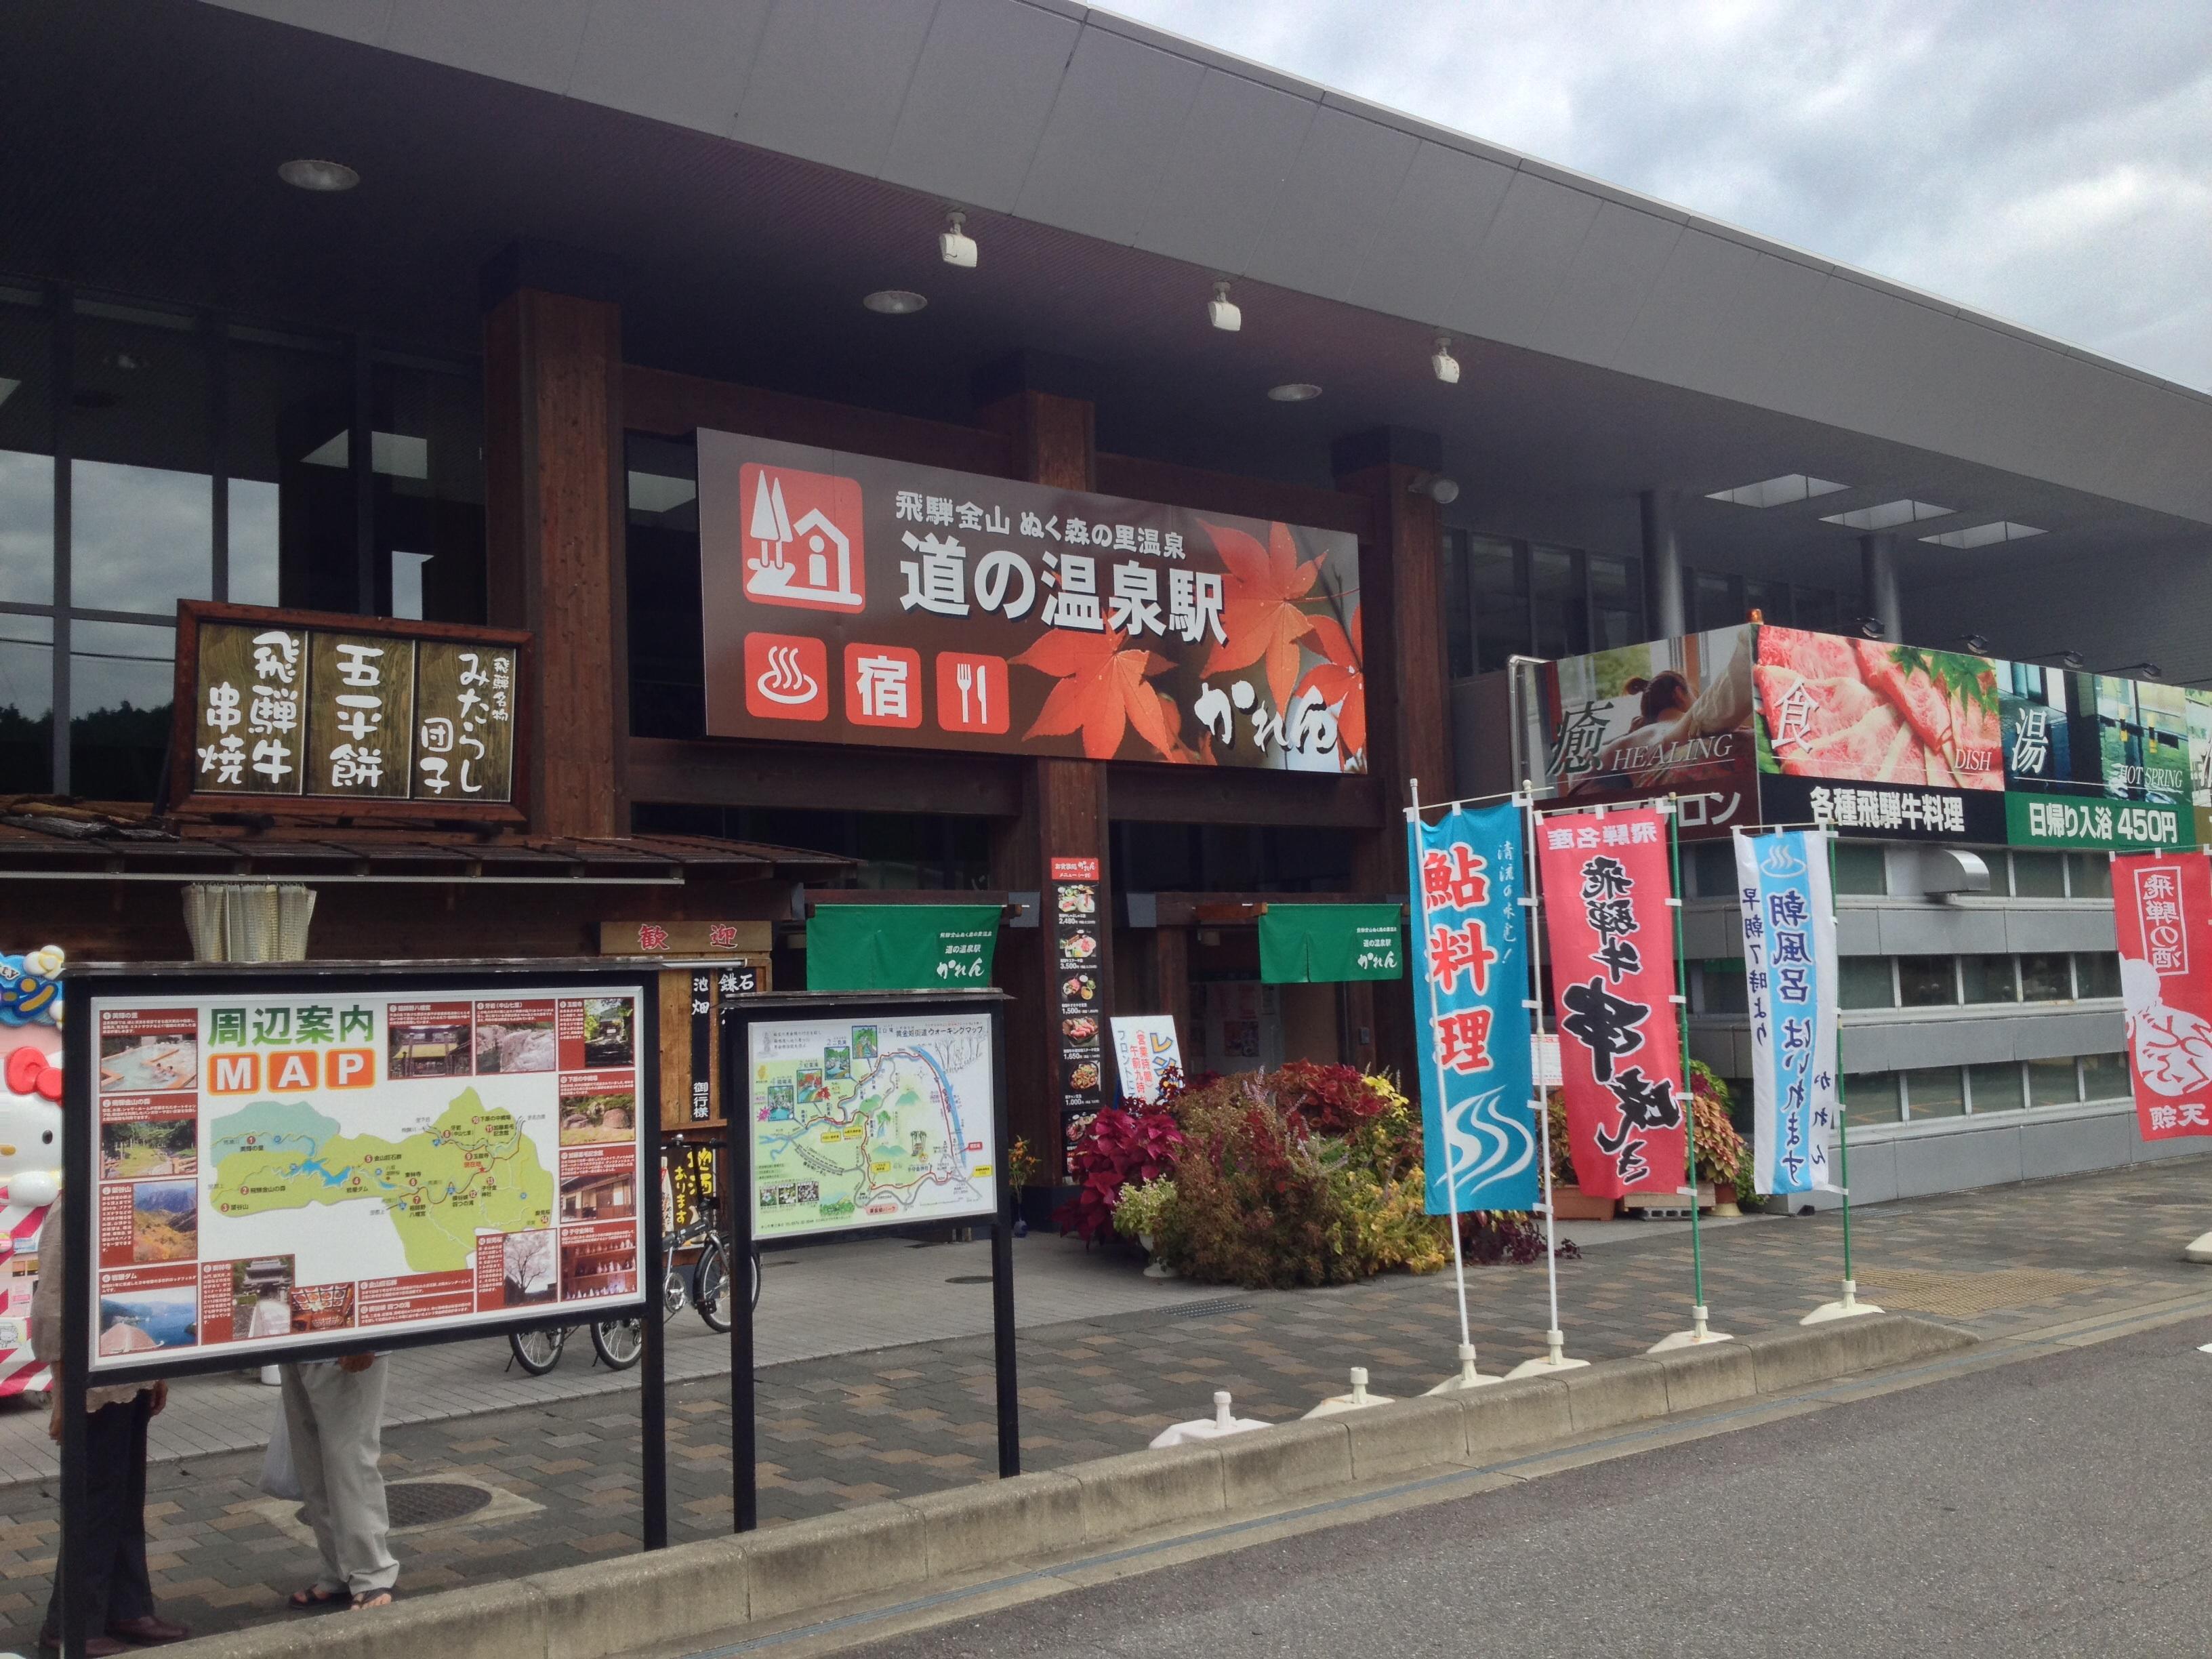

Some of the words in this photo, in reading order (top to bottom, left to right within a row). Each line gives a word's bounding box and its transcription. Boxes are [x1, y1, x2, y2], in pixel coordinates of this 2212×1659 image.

[895, 489, 1010, 535] 飛騨金山
[1021, 509, 1186, 560] ぬく森の里温泉
[899, 531, 1227, 643] 道の温泉駅
[249, 631, 300, 784] 飛騨牛
[329, 644, 384, 787] 五平餅
[493, 657, 510, 722] 飛騨名物
[856, 656, 909, 717] 宿
[197, 682, 246, 785] 串焼
[457, 653, 489, 792] みたらし
[1545, 700, 1614, 776] 癒
[1611, 734, 1733, 771] HEALING
[1771, 677, 1819, 754] 食
[1954, 748, 1992, 771] DISH
[2011, 707, 2049, 774] 湯
[2120, 765, 2143, 785] HOT
[2144, 767, 2184, 788] SPRING
[419, 718, 454, 794] 団子
[1809, 786, 1965, 832] 各種飛騨牛料理
[2029, 802, 2112, 840] 日帰り入浴
[2117, 808, 2178, 843] 450円
[638, 924, 738, 950] 歓迎
[945, 944, 981, 954] 道の温泉駅
[1363, 939, 1391, 947] 道の温泉駅
[1424, 842, 1496, 1072] 鮎料理
[207, 1006, 375, 1047] 周辺案内
[691, 977, 710, 1015] 池畑
[216, 1052, 365, 1091] MAP
[693, 1082, 710, 1118] 御一行様
[674, 1166, 688, 1224] あります
